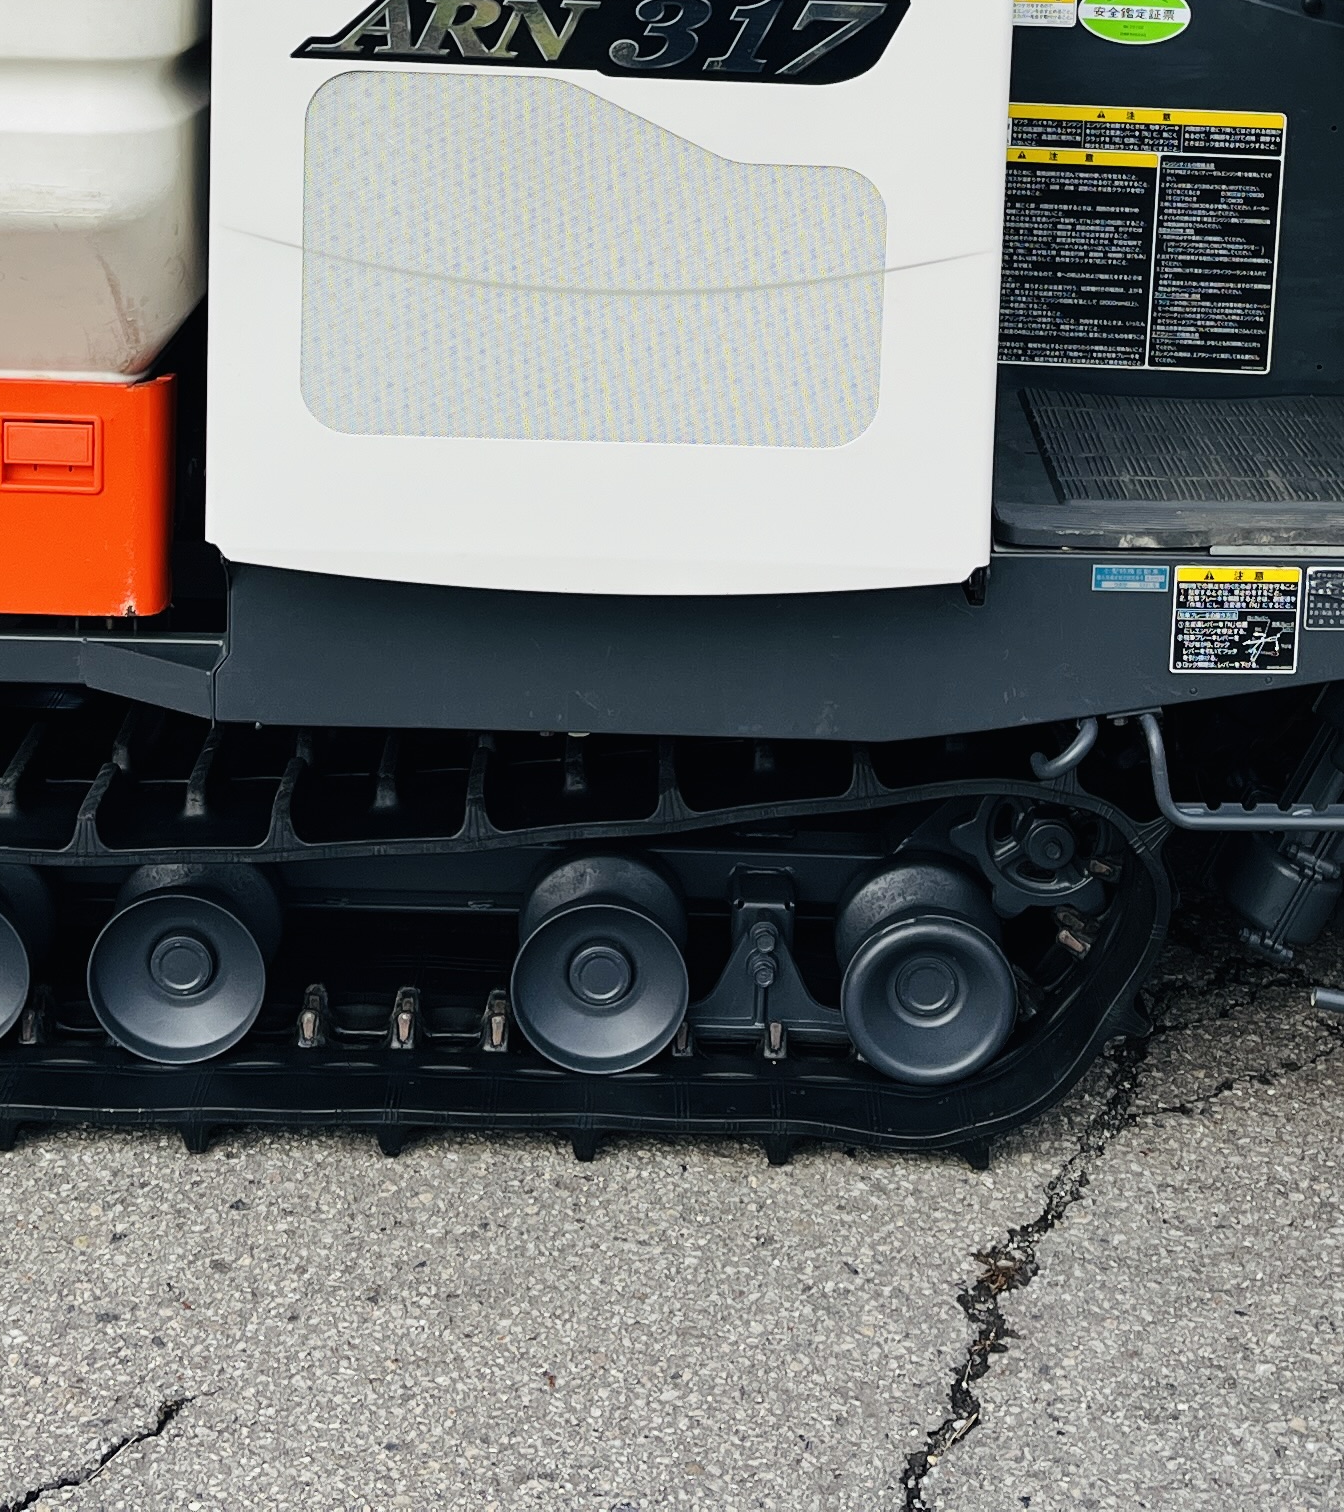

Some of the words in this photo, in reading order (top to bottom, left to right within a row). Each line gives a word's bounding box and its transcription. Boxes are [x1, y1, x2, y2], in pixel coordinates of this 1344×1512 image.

[1093, 6, 1175, 21] 安全鑑定証票
[1234, 571, 1264, 581] 注意
